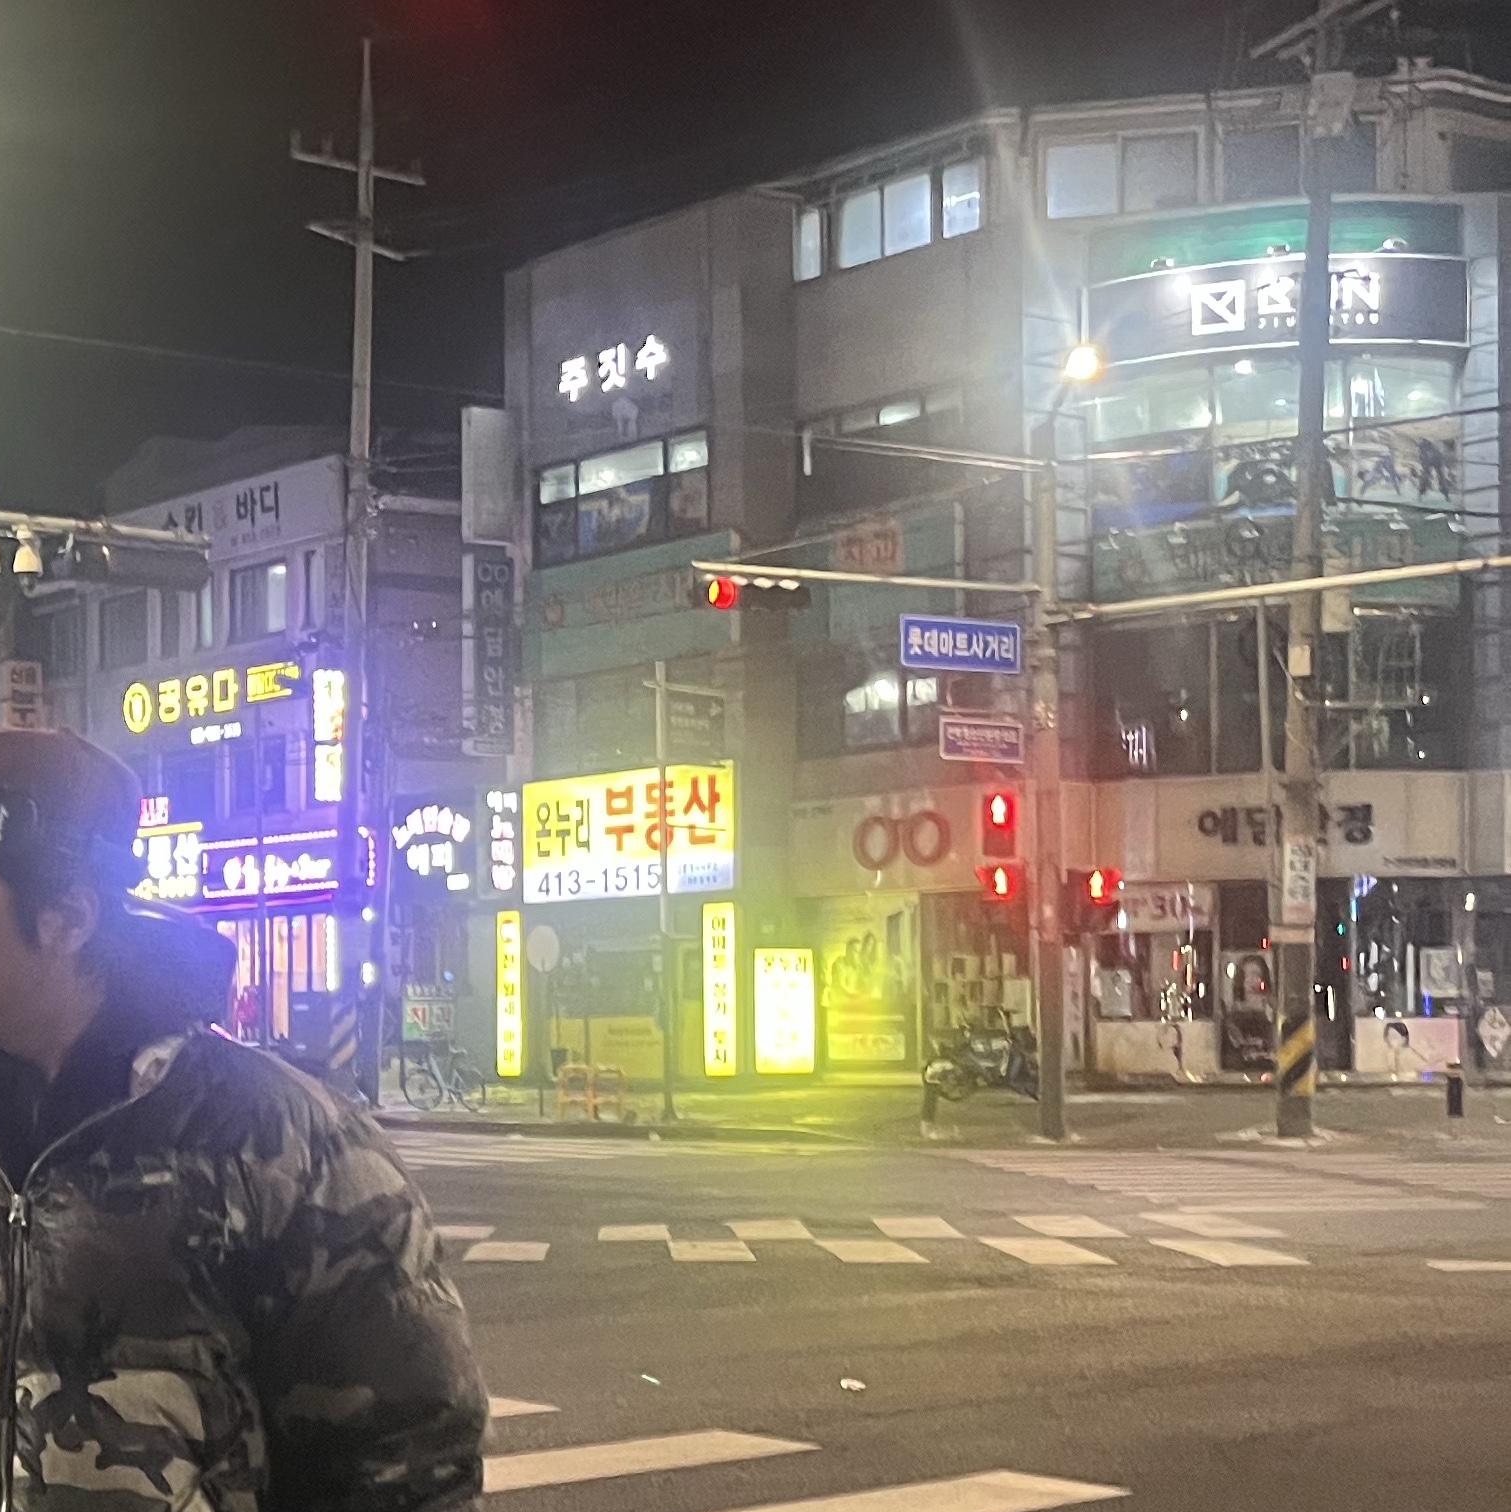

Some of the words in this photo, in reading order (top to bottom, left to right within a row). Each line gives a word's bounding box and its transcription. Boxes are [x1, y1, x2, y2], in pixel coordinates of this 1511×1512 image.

[557, 334, 668, 403] 주짓수
[236, 480, 281, 528] 바디
[907, 625, 1016, 663] 롯데마트사거리
[536, 798, 591, 858] 온누리
[604, 774, 721, 852] 부동산
[537, 863, 662, 897] 413-1515
